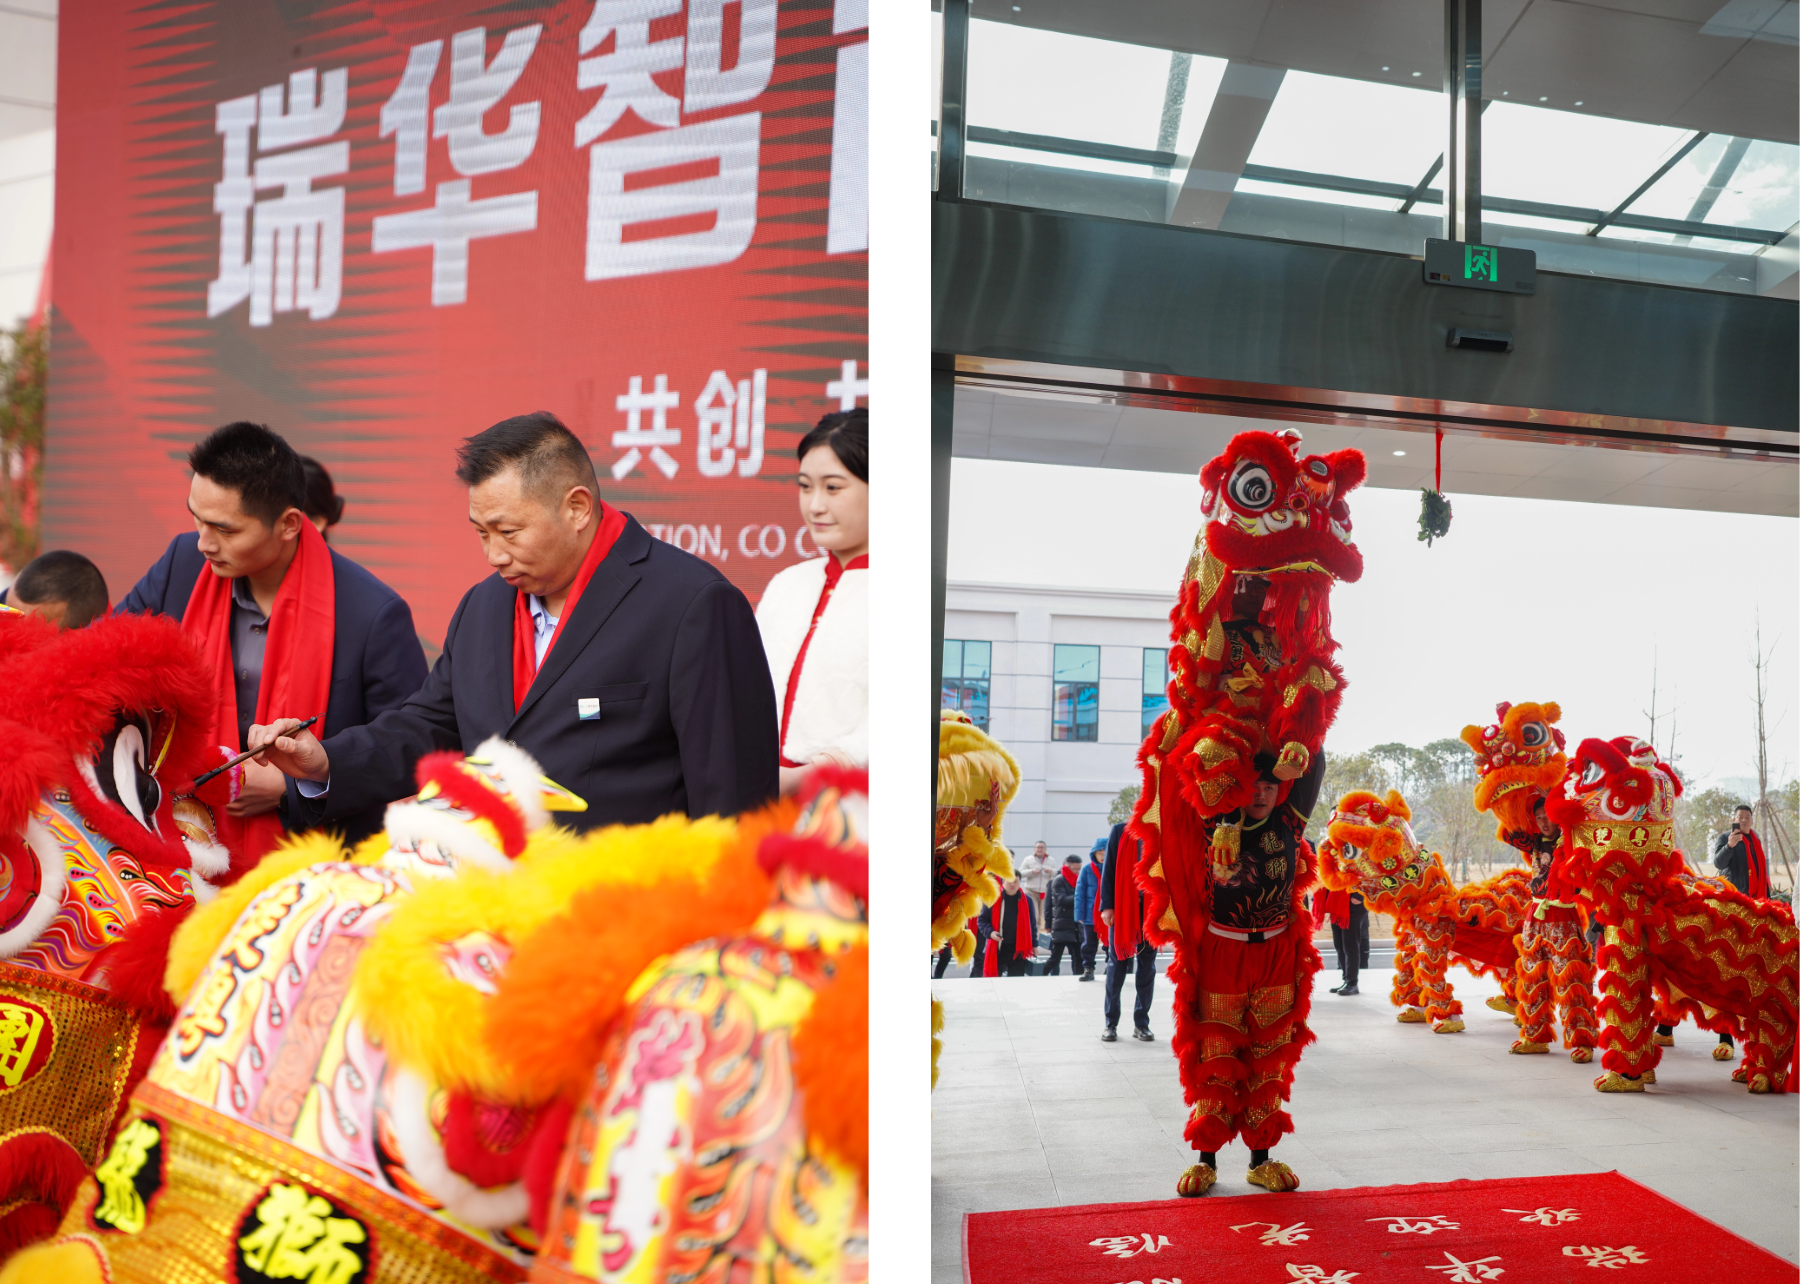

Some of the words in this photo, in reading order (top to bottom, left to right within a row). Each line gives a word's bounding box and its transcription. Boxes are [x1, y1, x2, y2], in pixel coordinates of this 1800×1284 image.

[207, 0, 869, 327] 瑞华智
[611, 367, 768, 482] 共创
[640, 523, 729, 562] TION,
[738, 523, 787, 558] CO
[1088, 1207, 1583, 1258] 欢迎光临
